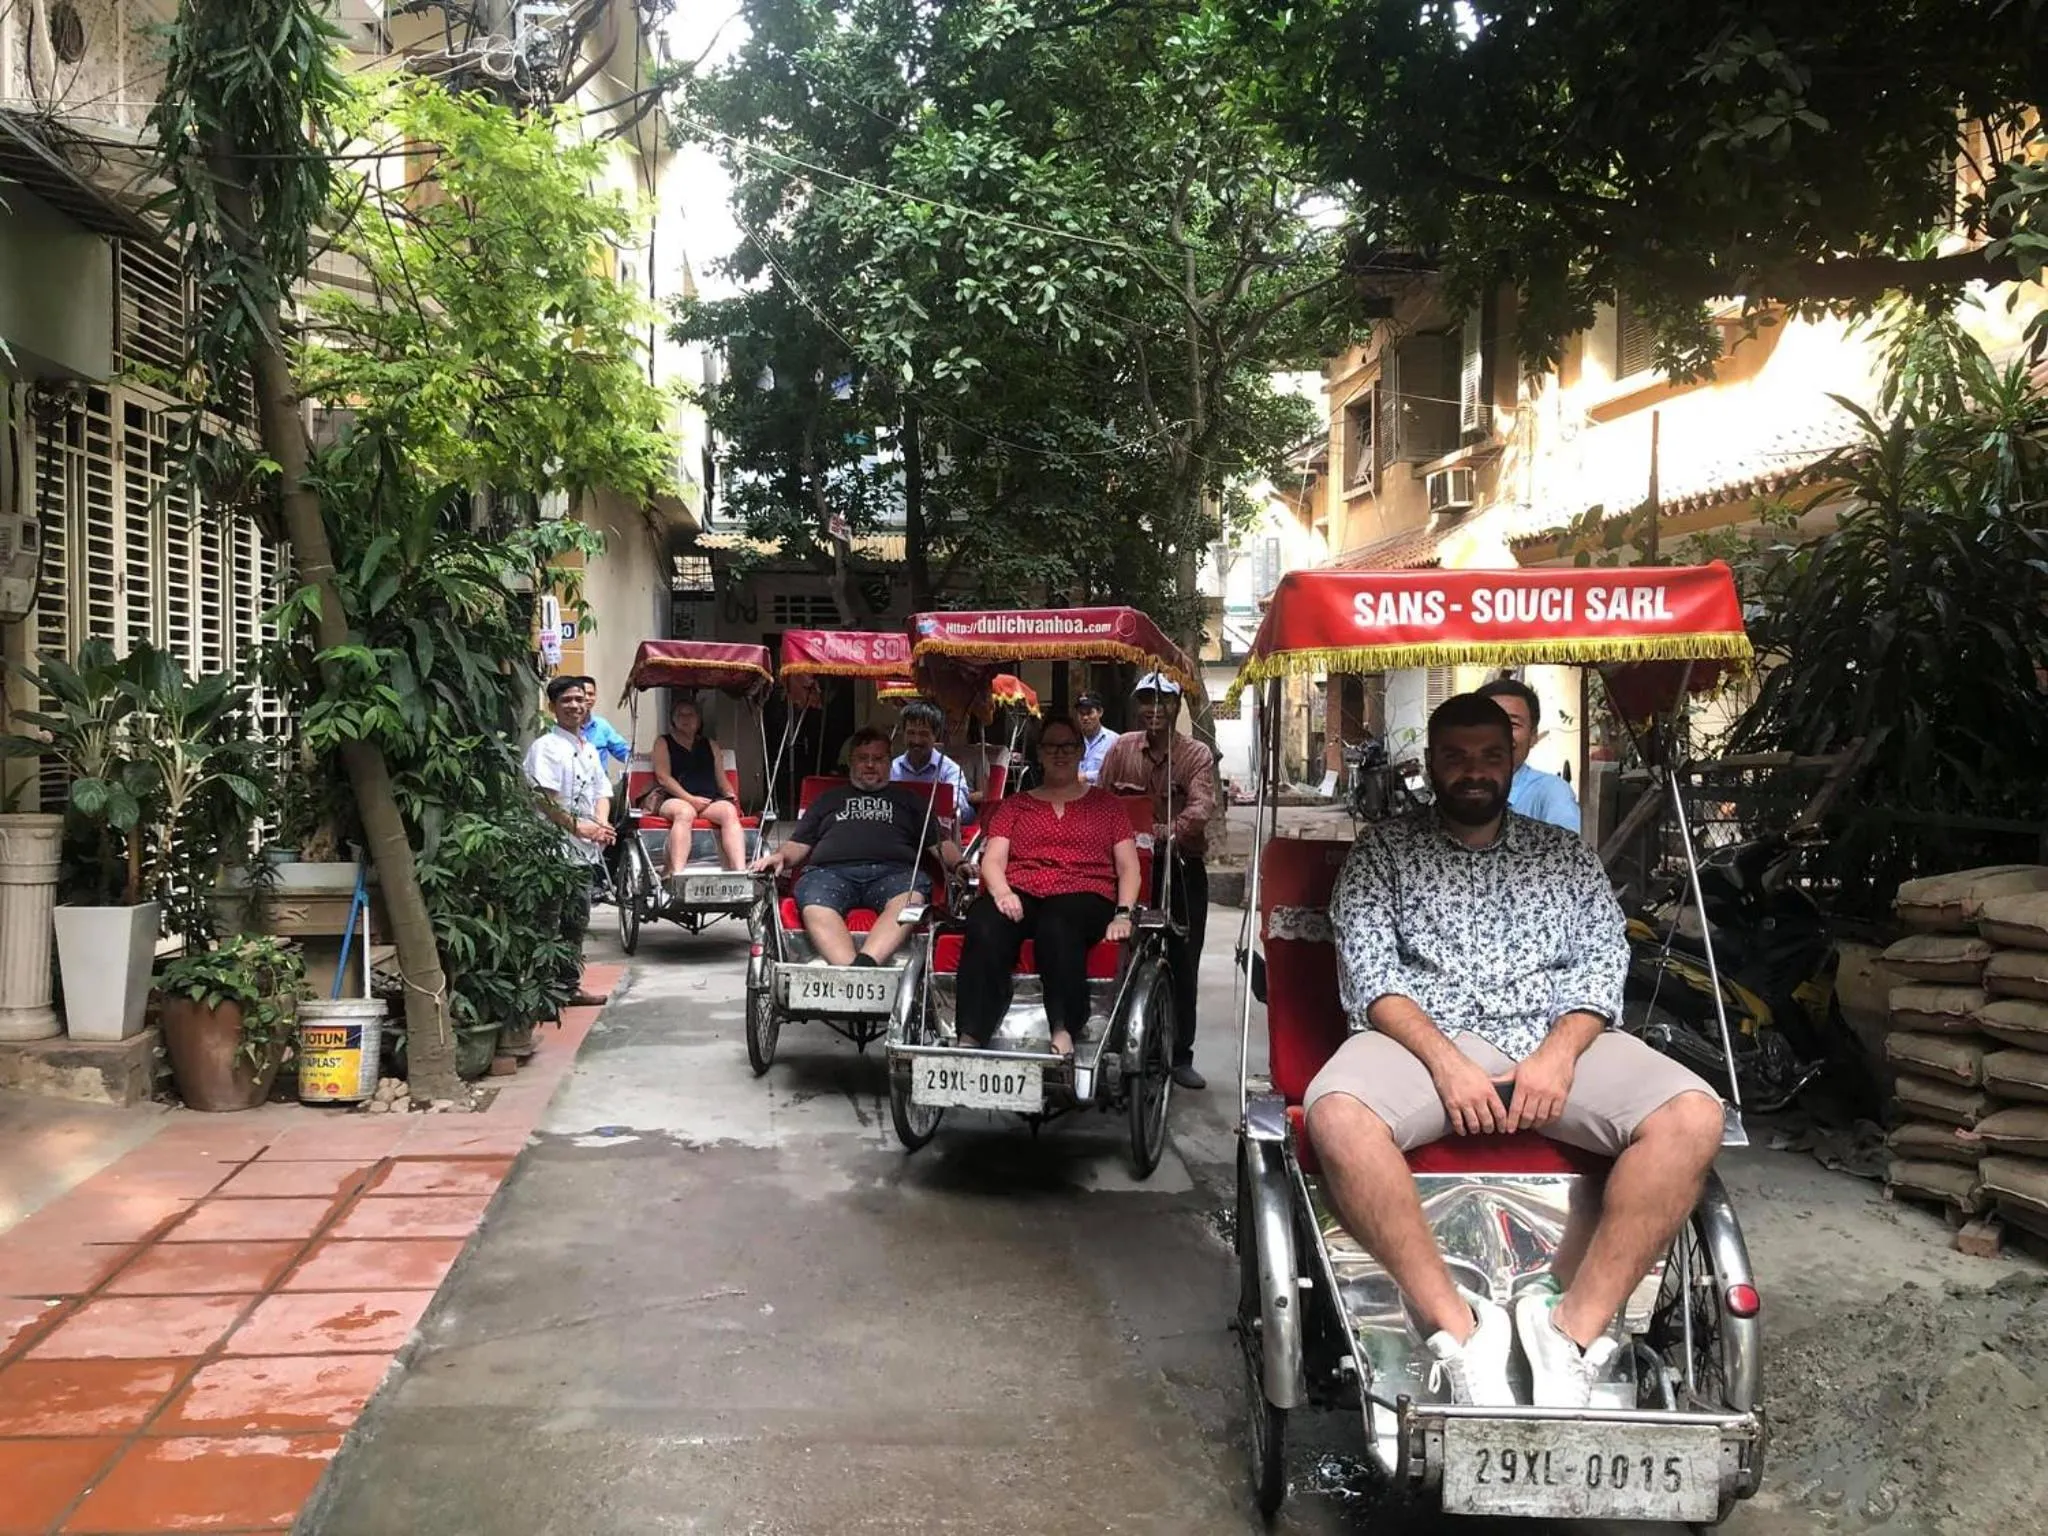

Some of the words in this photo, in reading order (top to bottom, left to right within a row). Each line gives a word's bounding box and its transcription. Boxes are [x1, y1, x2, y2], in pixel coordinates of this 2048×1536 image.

[1470, 587, 1574, 624] SOUCI
[1584, 586, 1674, 622] SARL
[811, 638, 866, 660] SANS
[802, 981, 887, 1001] 29XL-0053
[927, 1069, 1026, 1095] 29XL-0007
[1475, 1448, 1683, 1494] 29XL-0015
